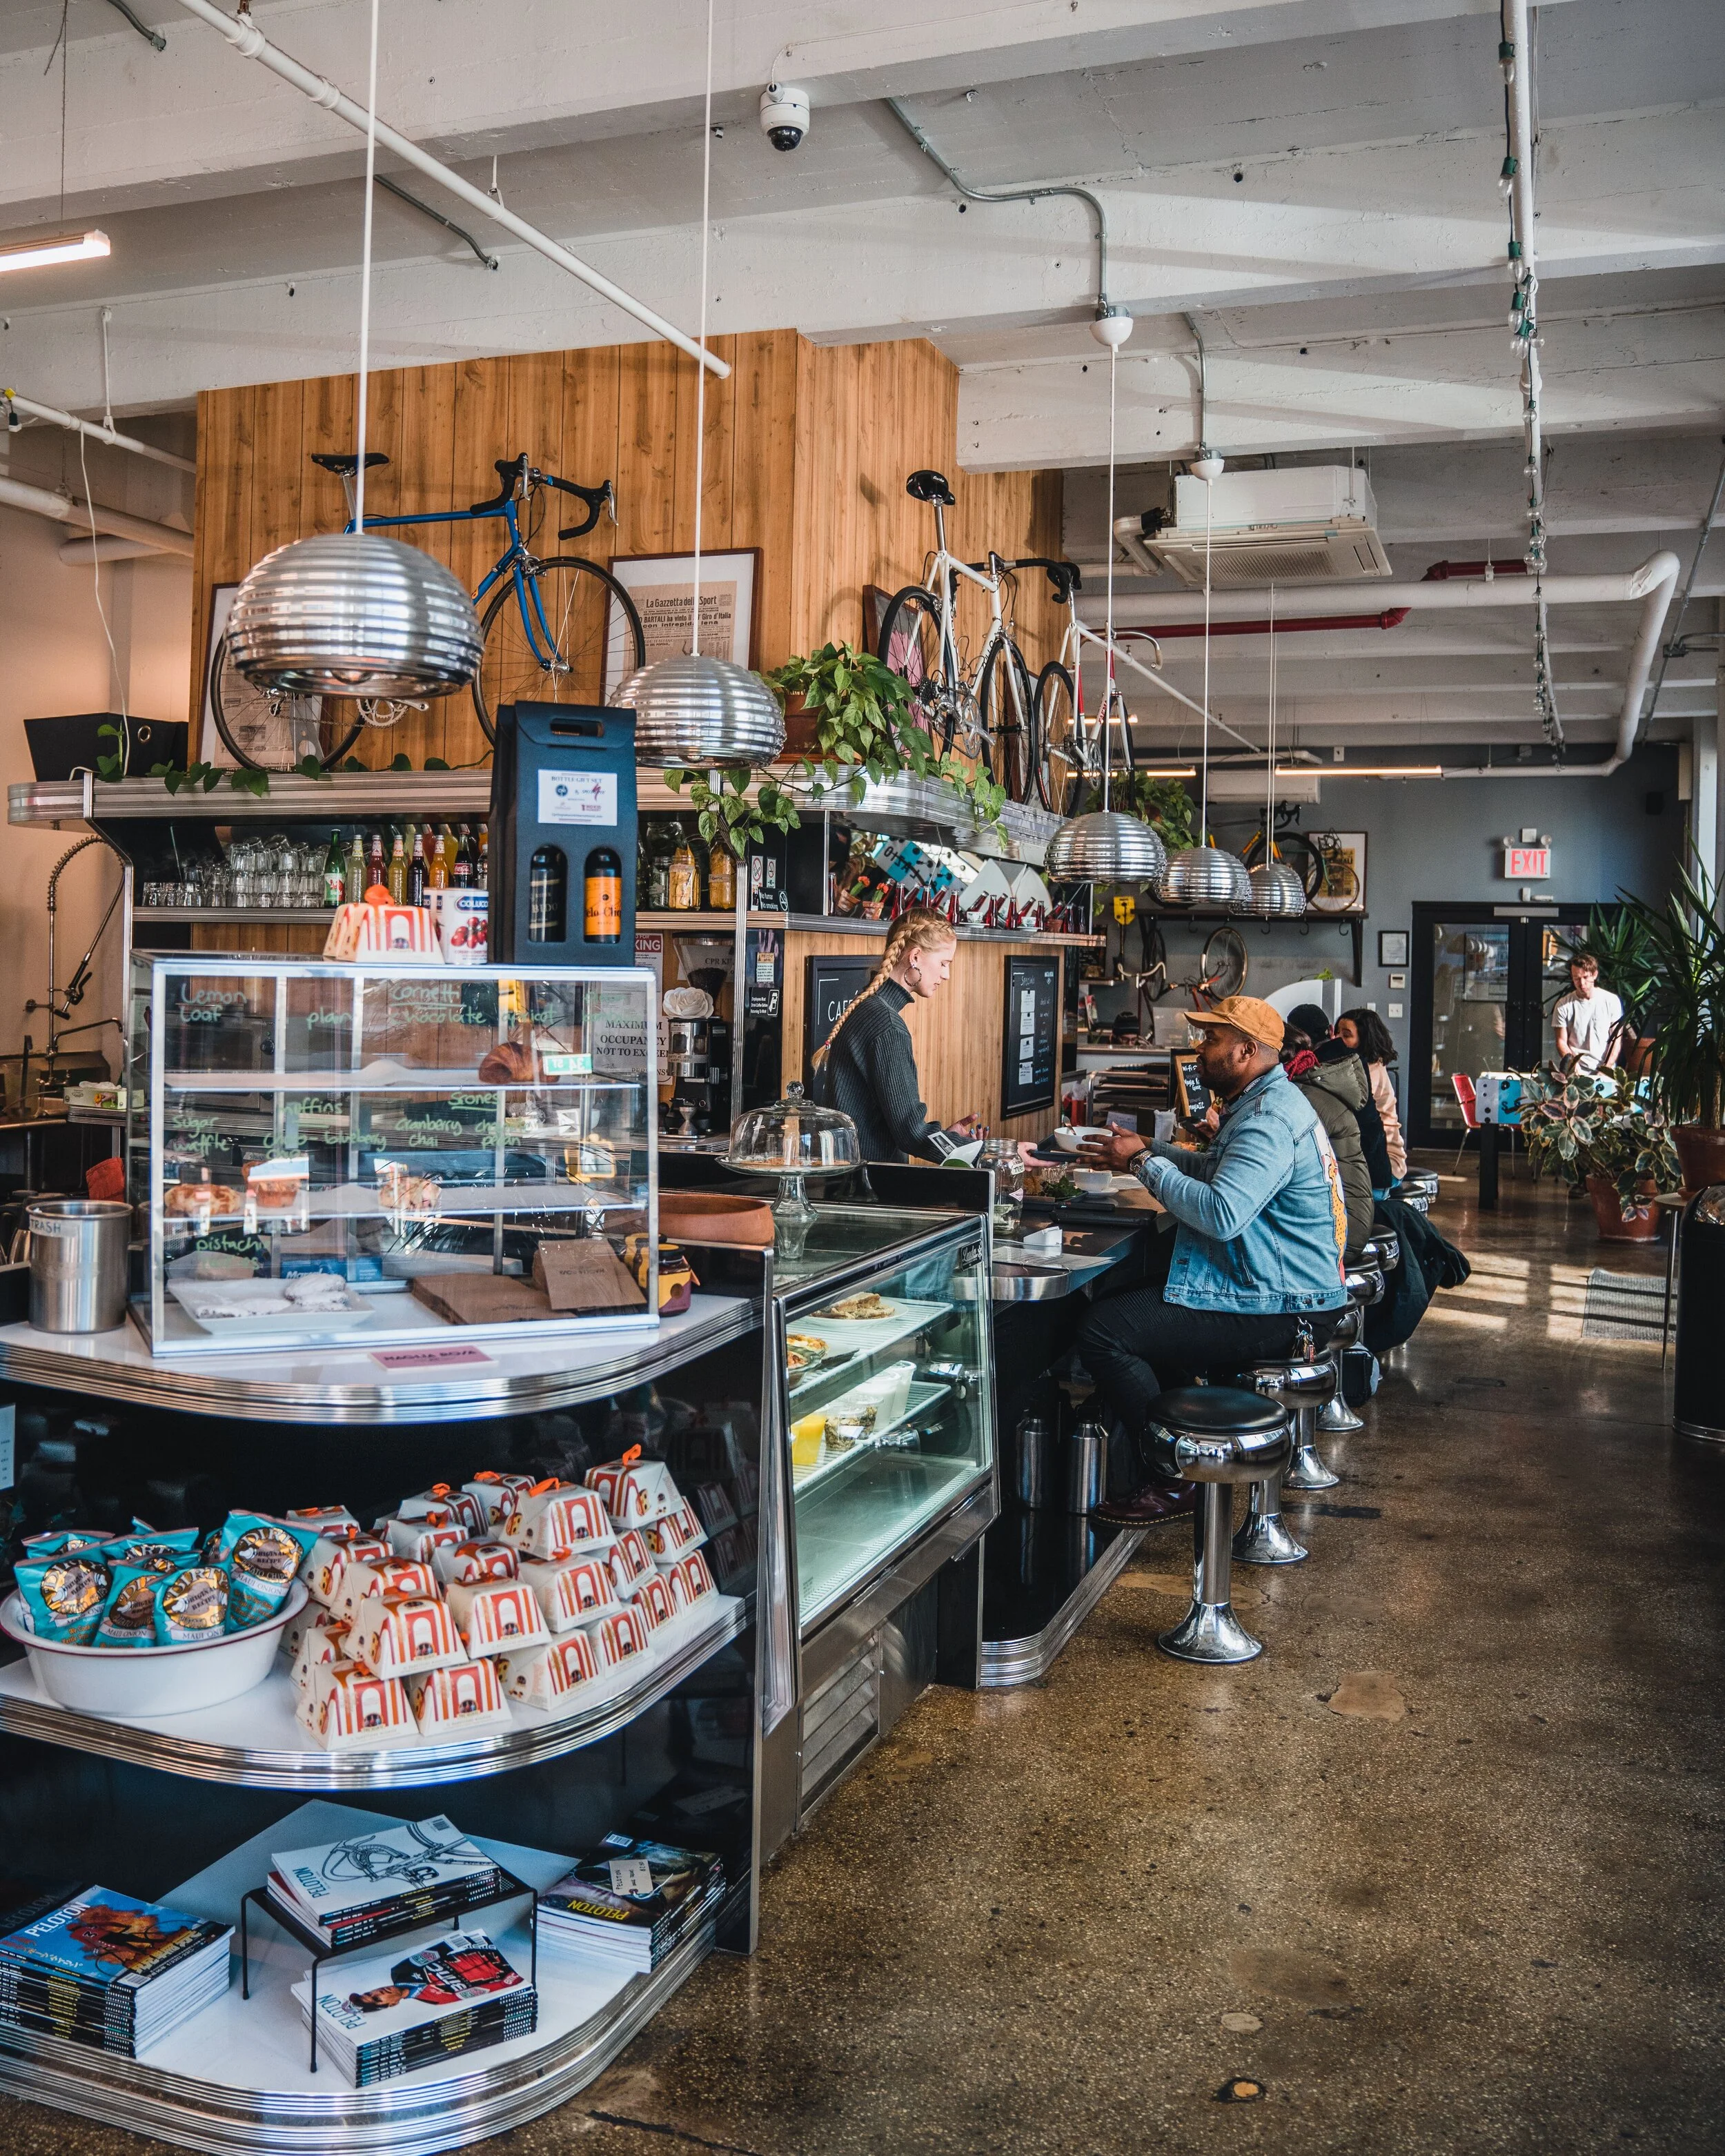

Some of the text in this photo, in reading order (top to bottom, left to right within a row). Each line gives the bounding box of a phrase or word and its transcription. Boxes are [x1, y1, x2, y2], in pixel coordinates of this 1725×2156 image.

[647, 599, 654, 608] La
[655, 597, 683, 607] Gazzetta
[699, 595, 717, 605] Sport
[1511, 850, 1547, 875] EXIT
[181, 982, 247, 1005] Lemon
[596, 1047, 616, 1056] NOT
[617, 1048, 631, 1056] TO
[448, 1092, 500, 1106] Scones
[30, 1218, 61, 1234] TRASH
[237, 1573, 282, 1596] MAUI ONION
[183, 1631, 204, 1639] MAUI
[293, 1866, 330, 1899] PELOTON
[24, 1900, 91, 1937] PELOTON
[567, 1899, 630, 1921] PELOTON
